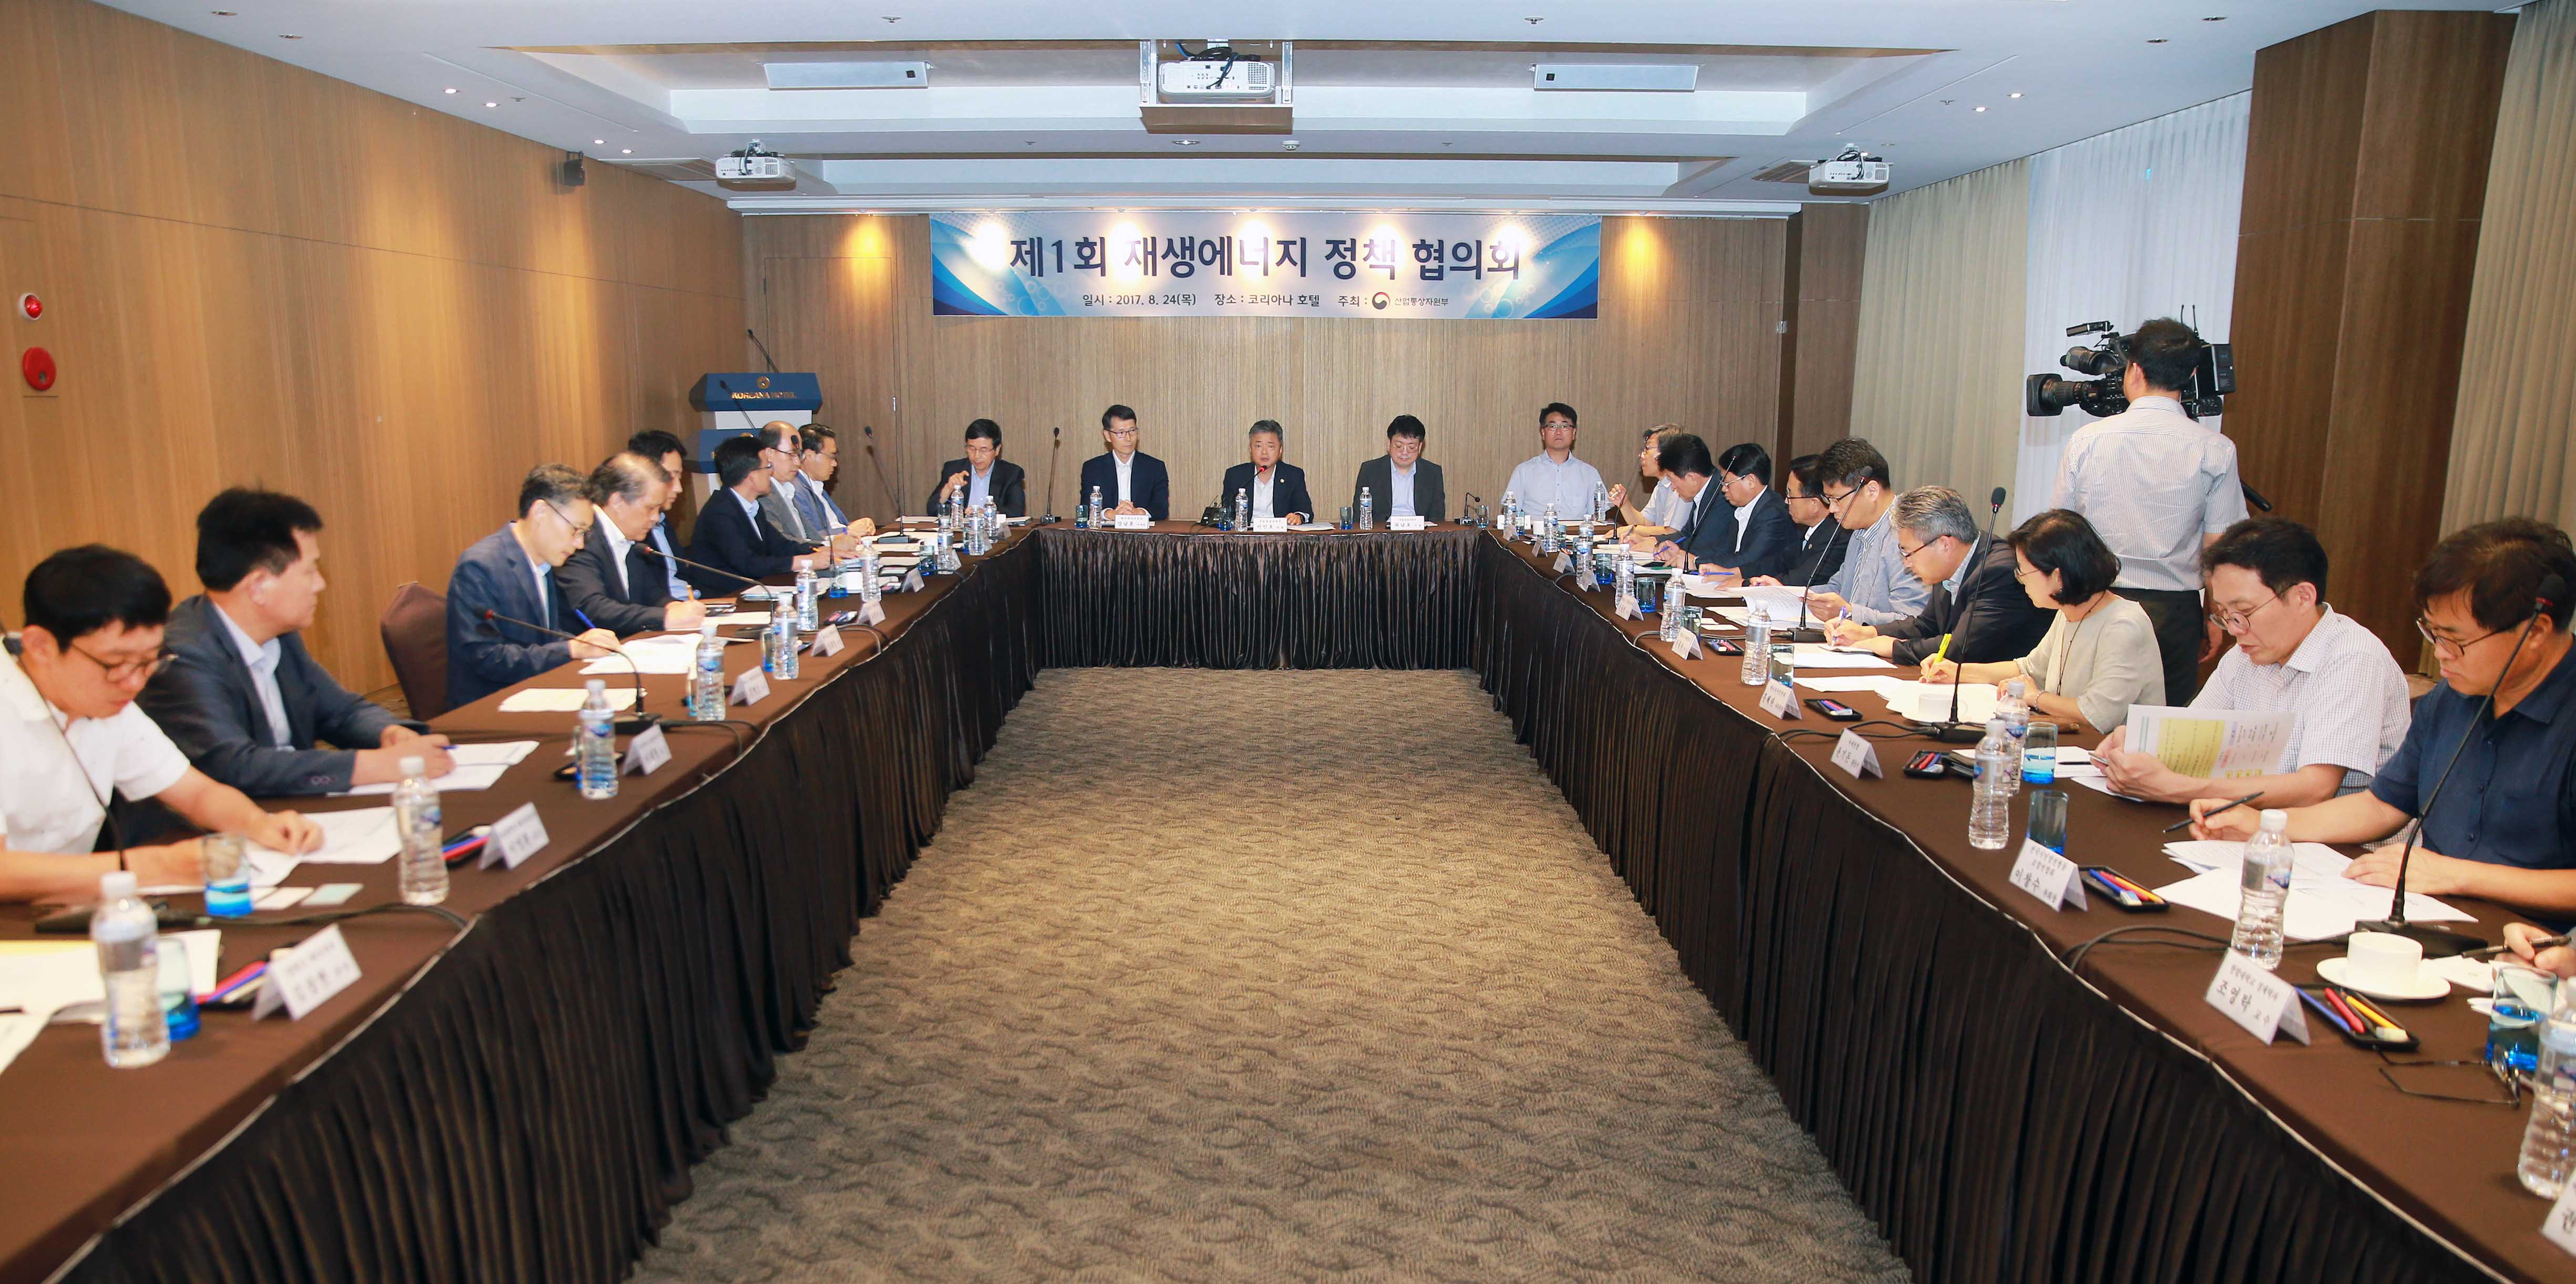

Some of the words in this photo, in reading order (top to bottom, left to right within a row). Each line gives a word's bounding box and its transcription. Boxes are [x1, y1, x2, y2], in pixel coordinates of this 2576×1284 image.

[1010, 236, 1106, 277] 제1회
[1125, 236, 1307, 278] 재생에너지
[1325, 237, 1396, 280] 정책
[1411, 238, 1520, 281] 협의회
[1116, 295, 1144, 305] 2017.
[1148, 294, 1159, 305] 8.
[1162, 294, 1197, 306] 24(목)
[1248, 294, 1293, 306] 코리아나
[1297, 294, 1320, 307] 호텔
[1394, 297, 1449, 307] 산업통상자원부
